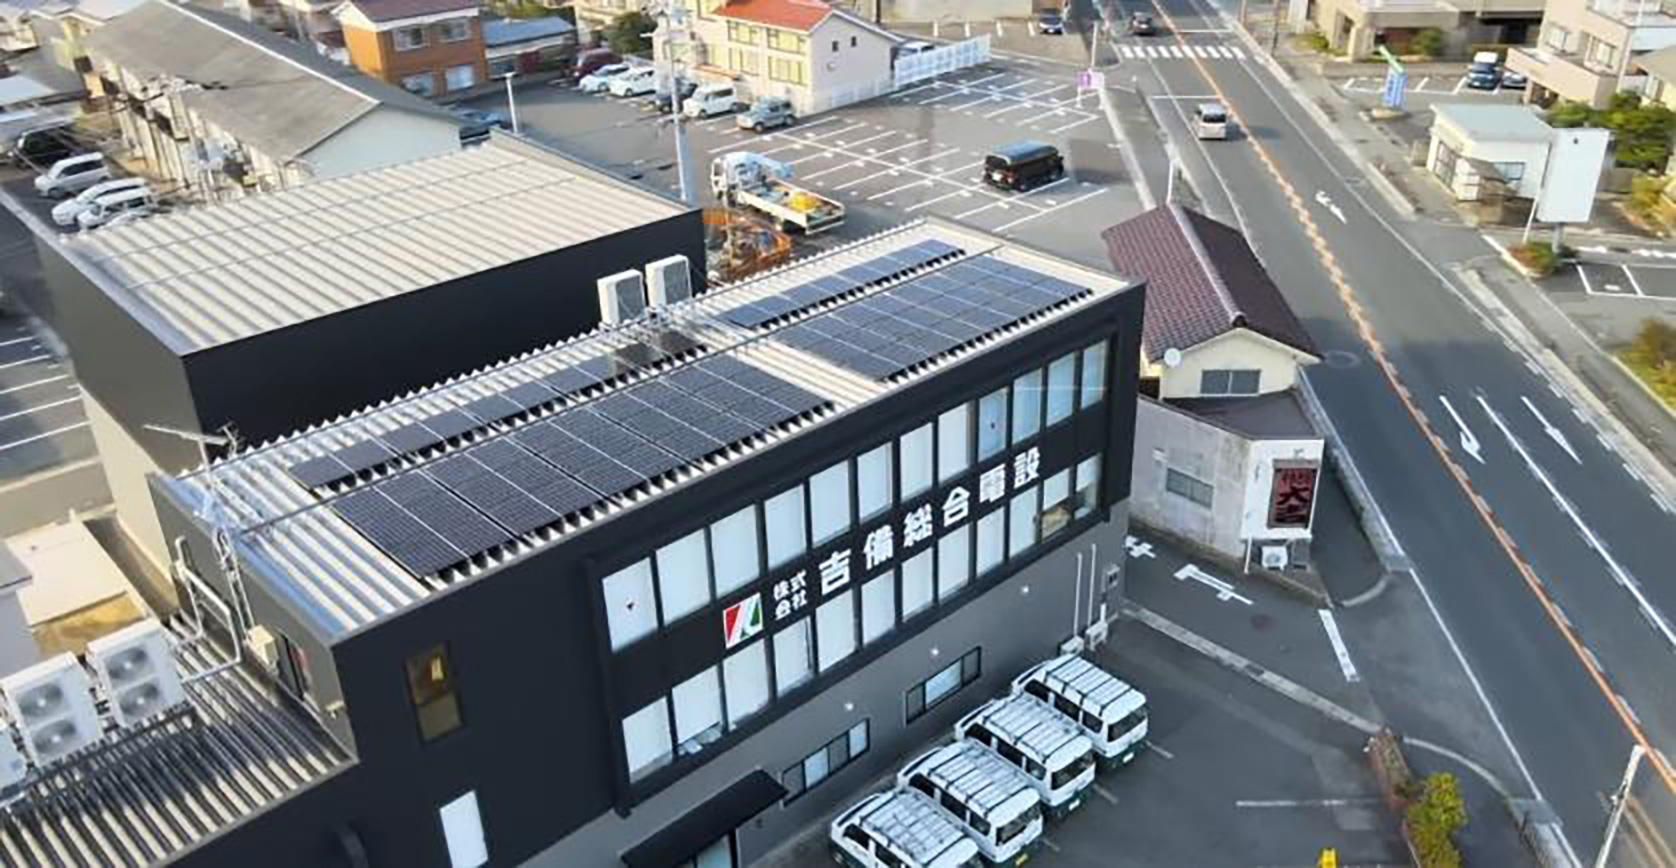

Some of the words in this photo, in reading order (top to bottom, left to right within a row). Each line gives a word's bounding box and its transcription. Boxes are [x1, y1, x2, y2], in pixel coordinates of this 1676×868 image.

[818, 446, 1041, 596] 吉備総合電設
[773, 570, 807, 601] 株式
[775, 589, 808, 621] 会社
